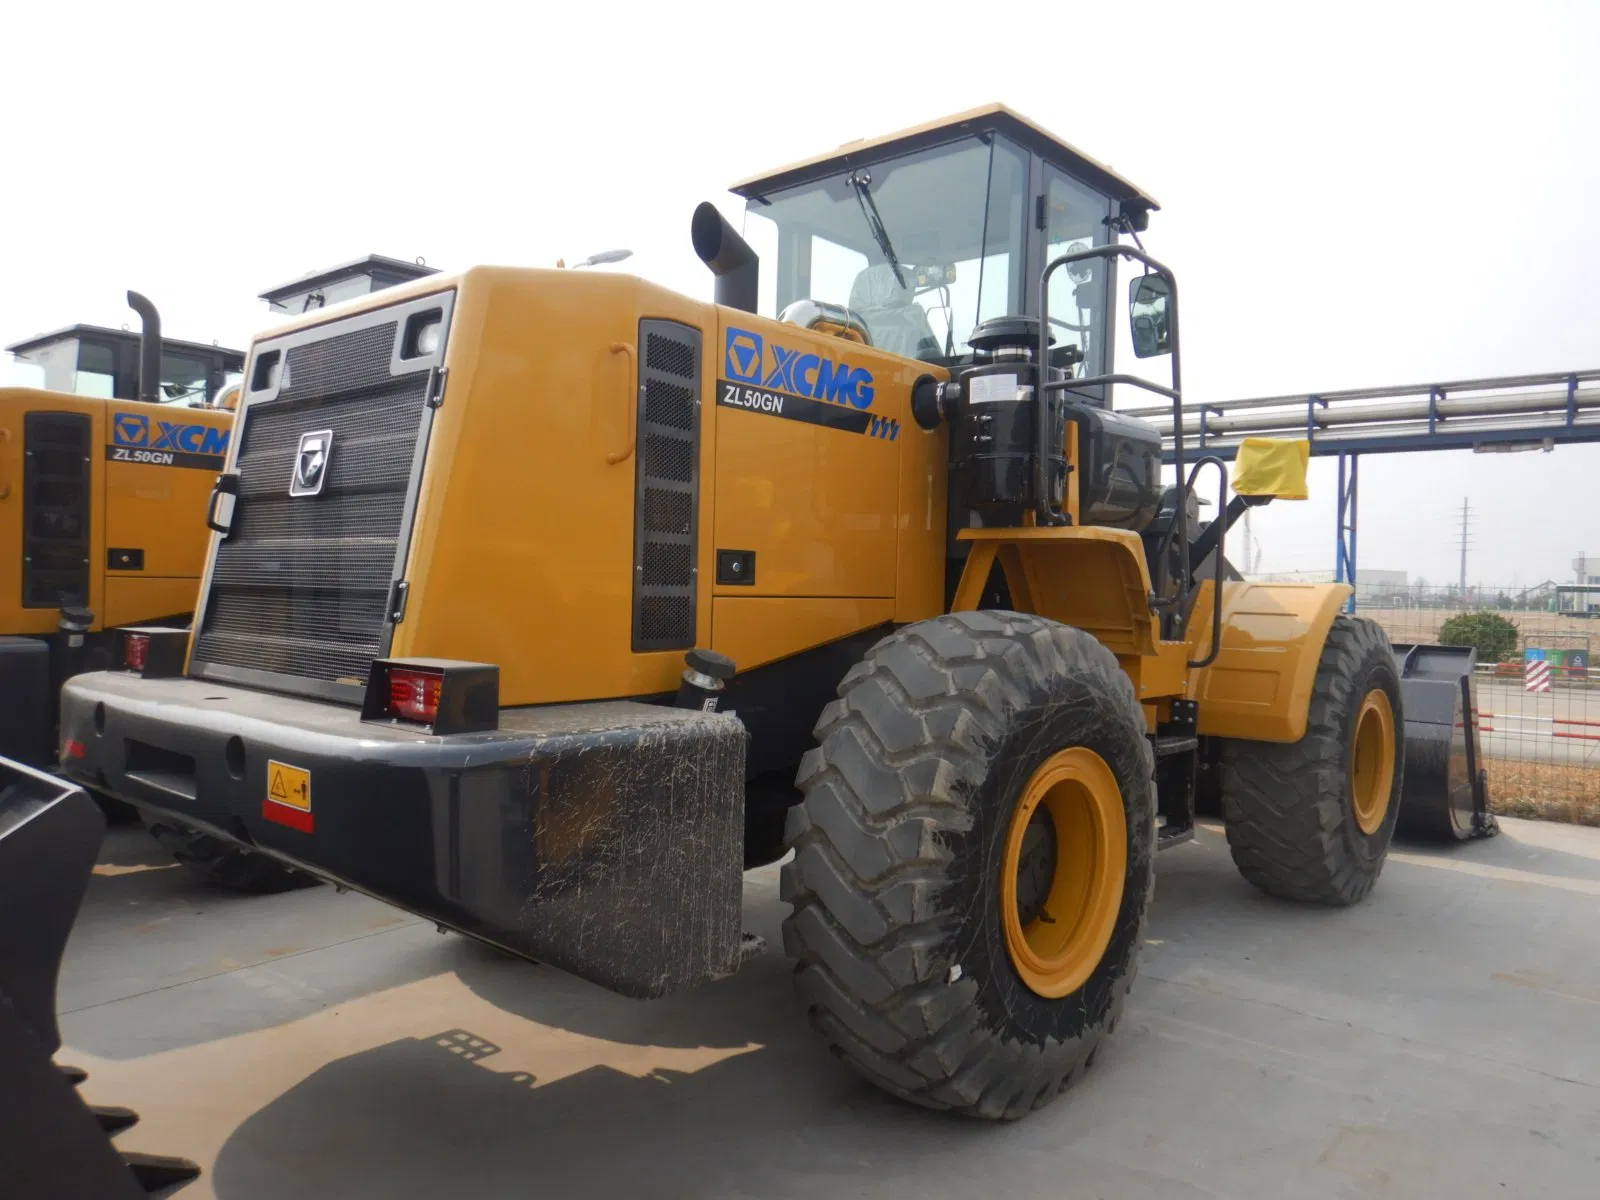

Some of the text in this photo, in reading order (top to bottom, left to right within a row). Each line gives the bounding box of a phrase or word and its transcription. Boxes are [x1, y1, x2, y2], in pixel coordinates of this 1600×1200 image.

[763, 344, 874, 409] XCMG
[723, 385, 784, 413] ZL50GN
[150, 421, 230, 454] XCM
[113, 448, 174, 464] ZL50GN
